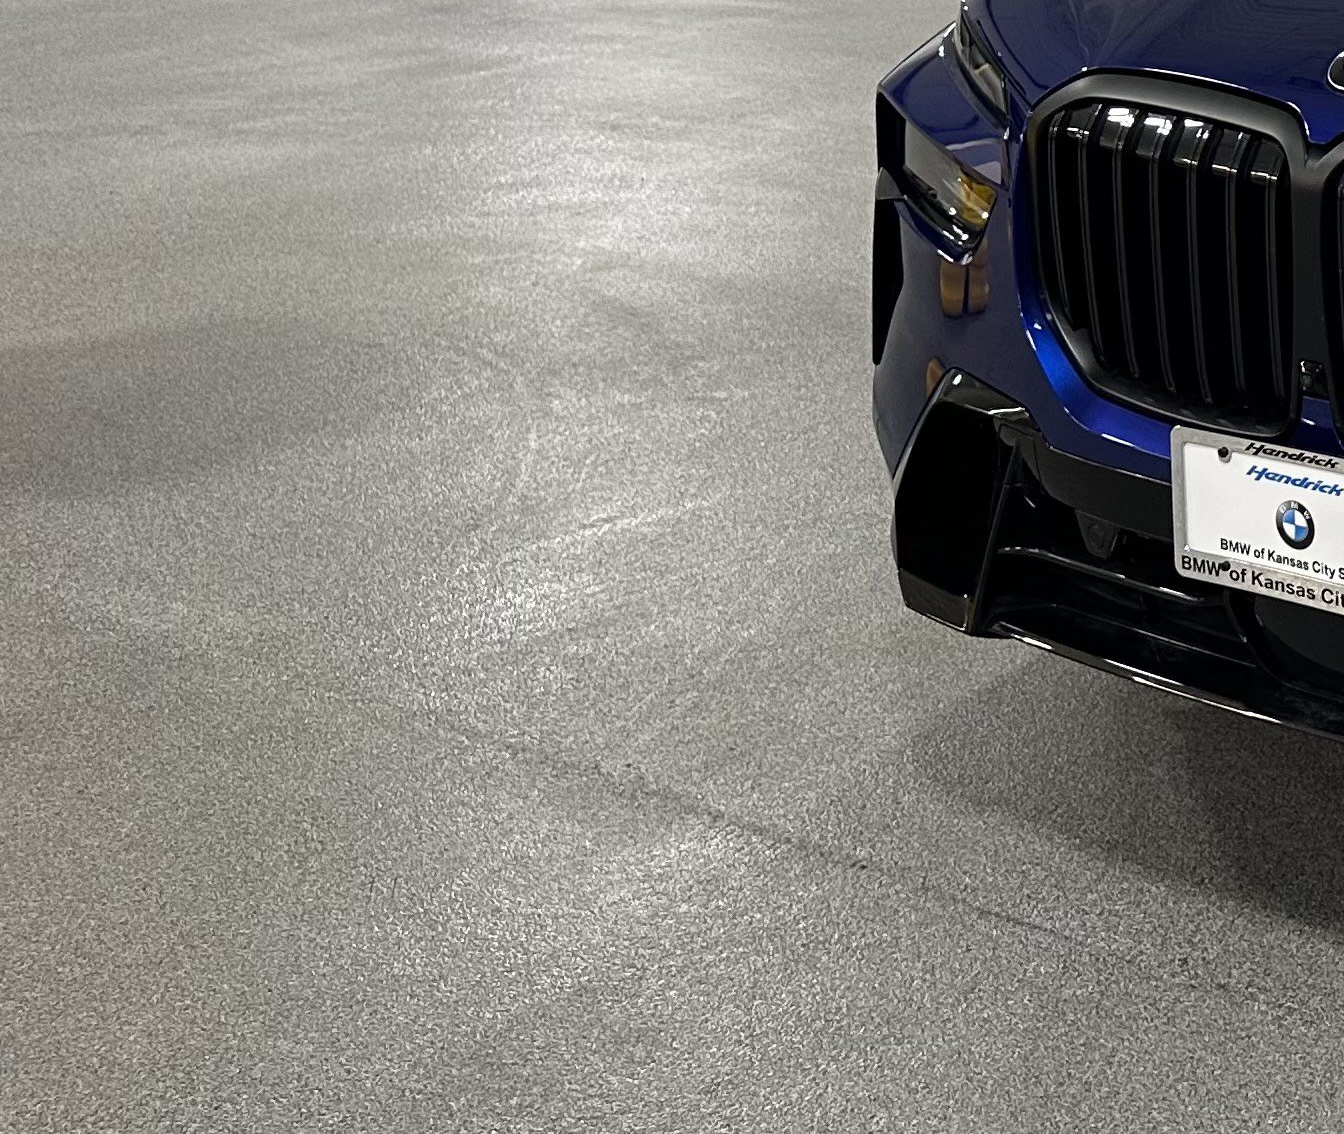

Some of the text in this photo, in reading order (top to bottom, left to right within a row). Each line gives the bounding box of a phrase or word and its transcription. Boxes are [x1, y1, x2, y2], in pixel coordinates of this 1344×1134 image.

[1245, 443, 1339, 468] Hendrick
[1246, 465, 1344, 496] Hendrick
[1220, 538, 1251, 556] BMW
[1253, 548, 1265, 559] of
[1267, 549, 1309, 570] Kansas
[1312, 560, 1336, 580] City
[1181, 555, 1221, 577] BMW
[1229, 568, 1247, 583] of
[1251, 570, 1316, 601] Kansas
